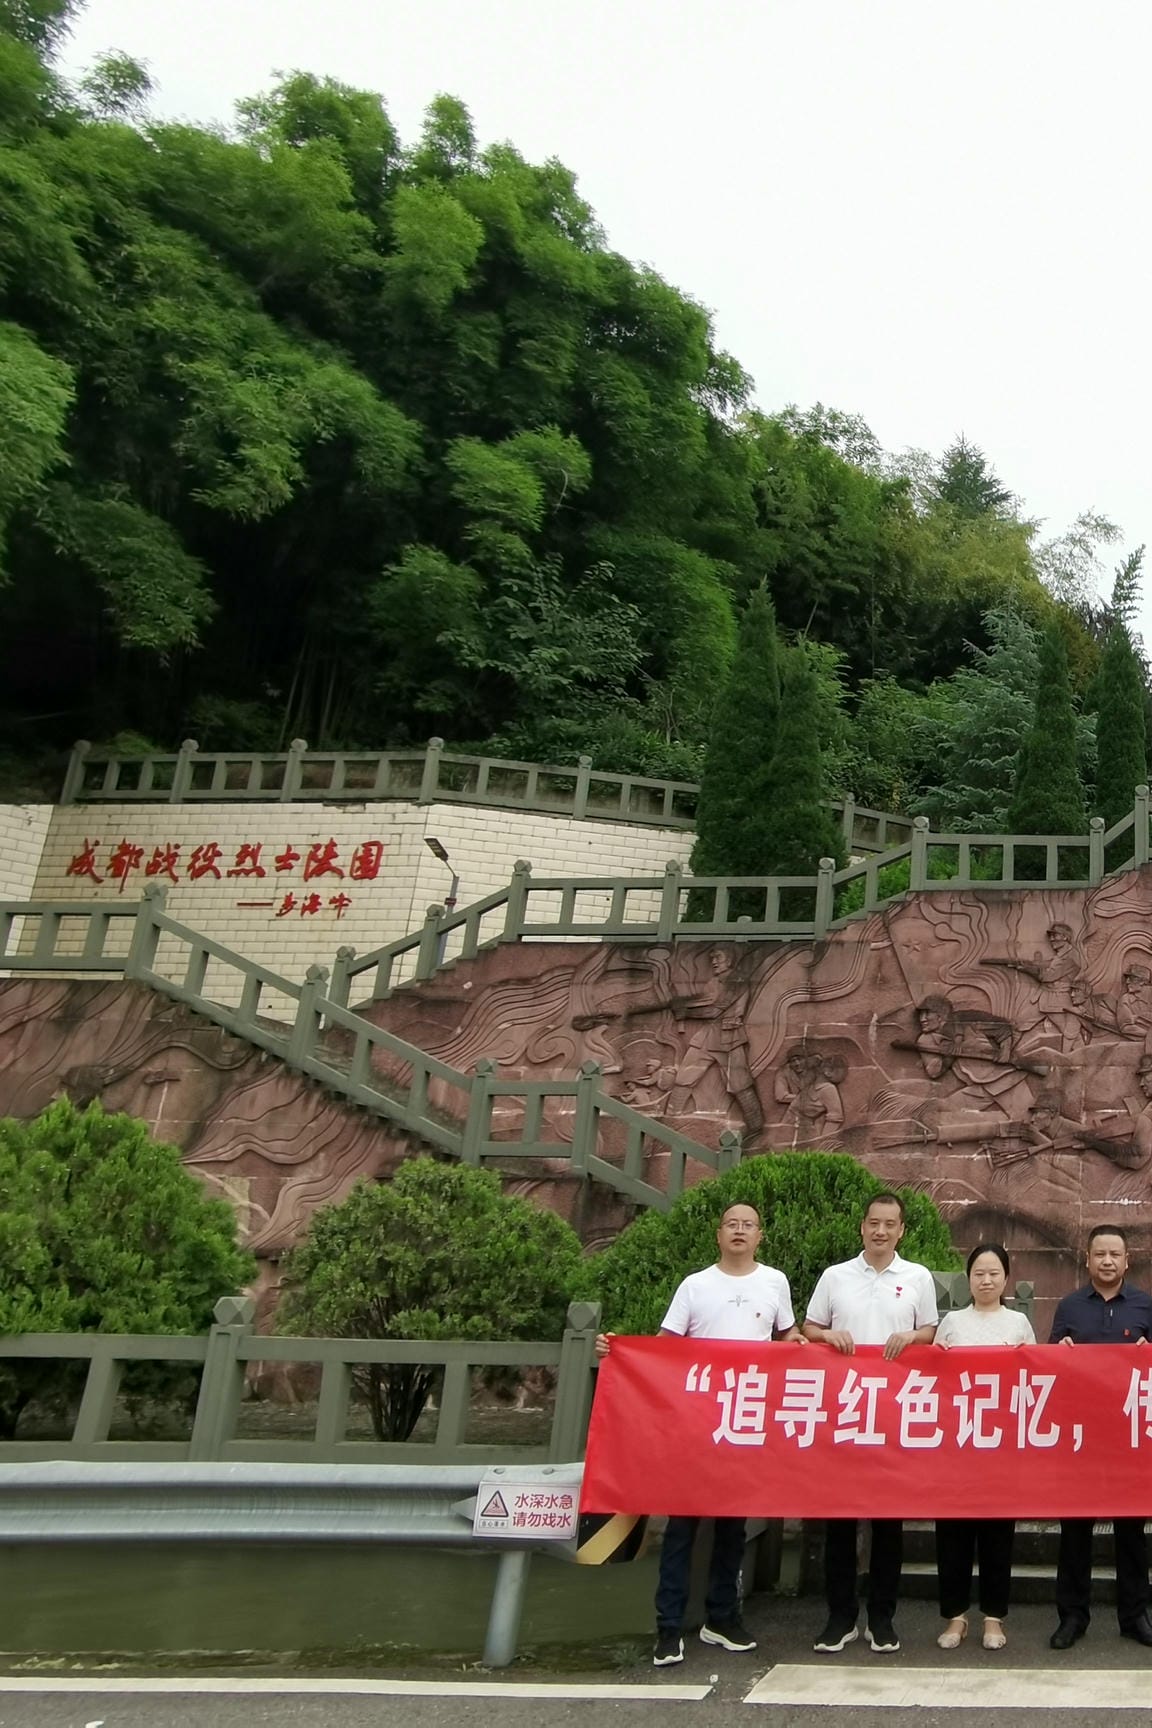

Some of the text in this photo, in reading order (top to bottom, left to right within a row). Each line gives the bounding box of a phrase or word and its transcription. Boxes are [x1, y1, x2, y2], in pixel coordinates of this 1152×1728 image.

[66, 837, 385, 893] 成都战役烈士陵园
[514, 1492, 574, 1510] 水深水急
[512, 1511, 572, 1528] 请勿戏水
